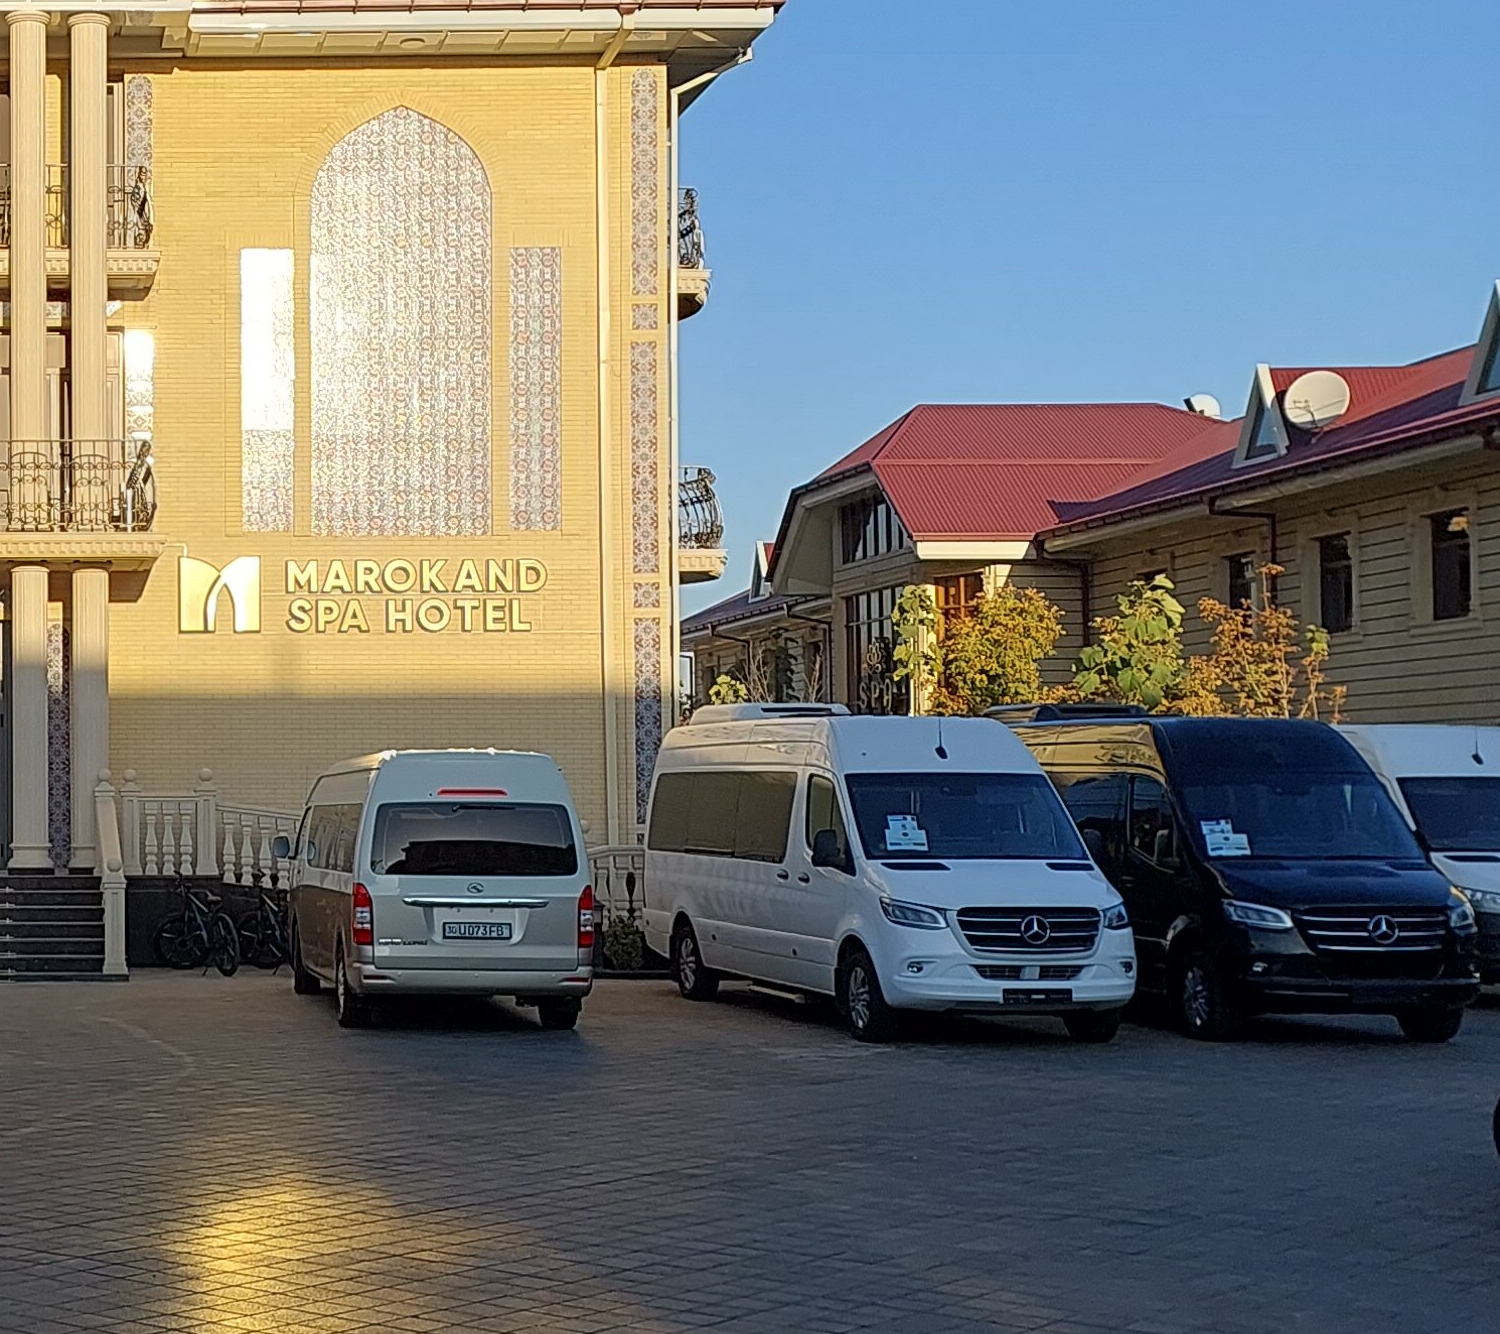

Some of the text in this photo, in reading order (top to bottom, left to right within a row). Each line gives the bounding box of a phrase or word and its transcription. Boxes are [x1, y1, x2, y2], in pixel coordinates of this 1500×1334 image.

[285, 557, 549, 594] MAROKAND
[285, 597, 533, 633] SPA HOTEL
[859, 678, 892, 713] SPA
[458, 924, 504, 936] U073FB
